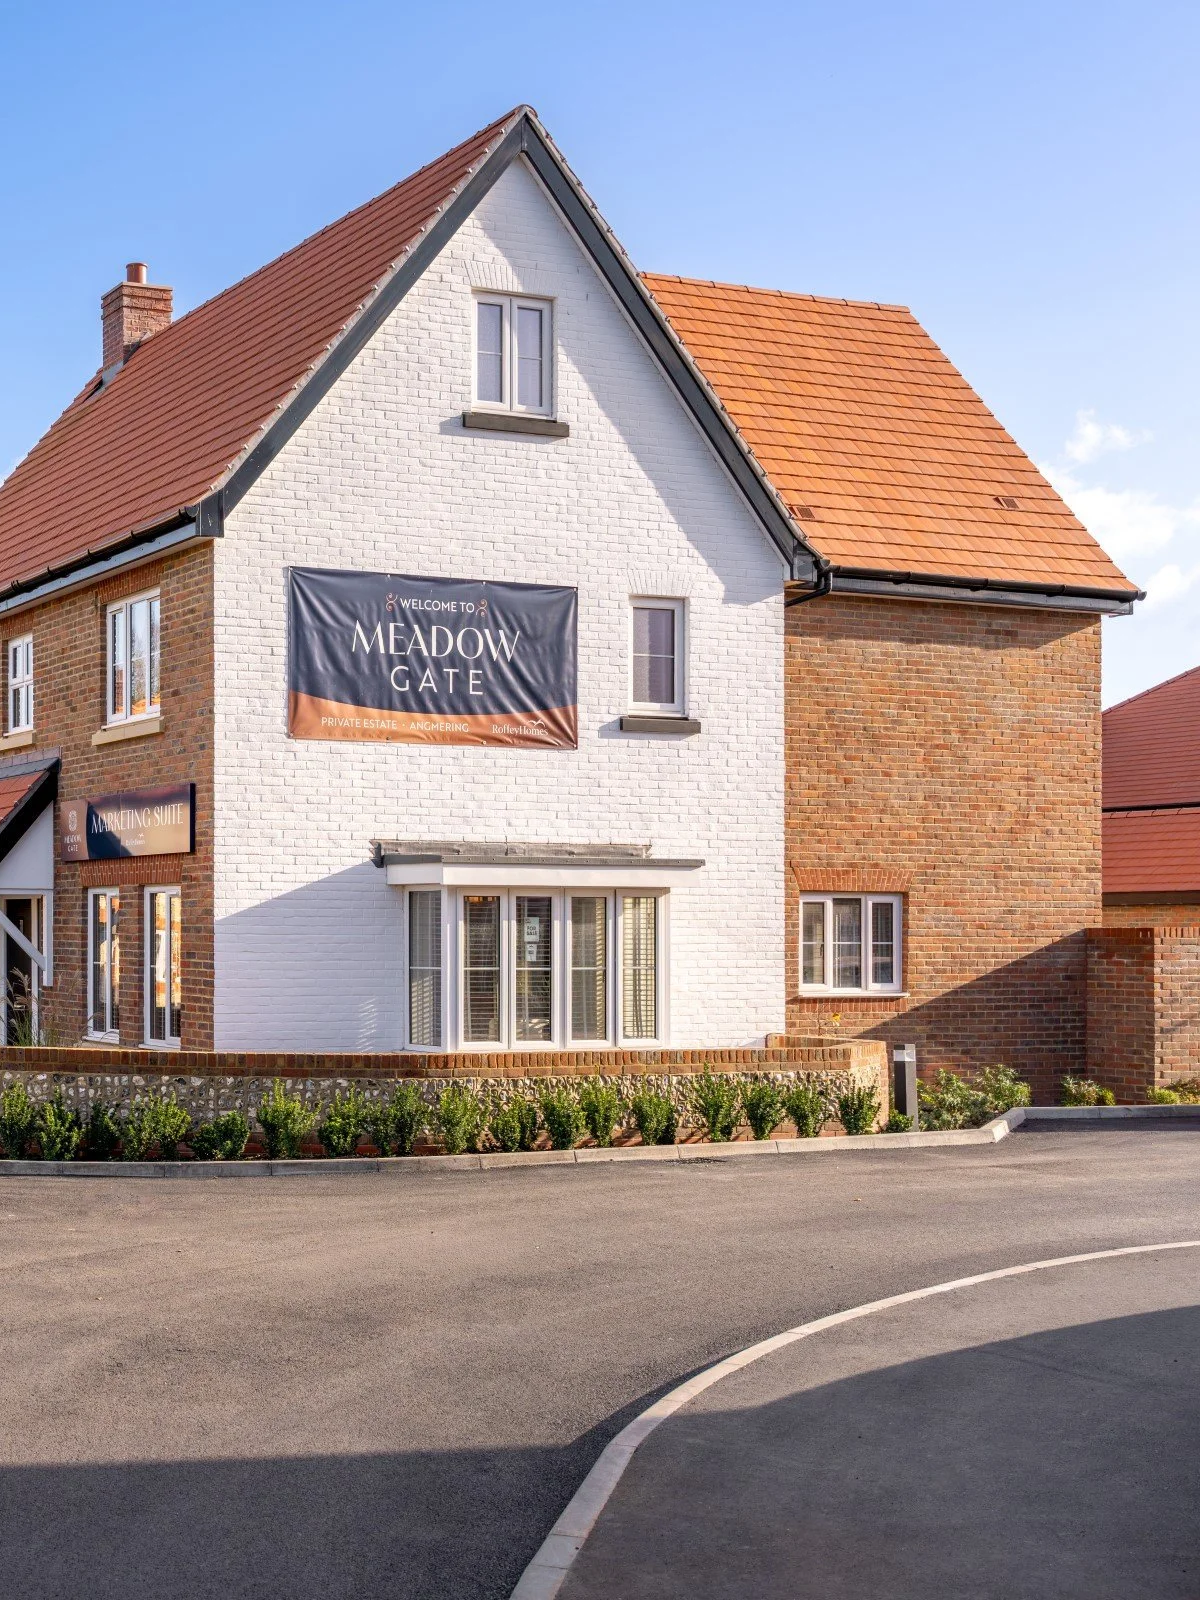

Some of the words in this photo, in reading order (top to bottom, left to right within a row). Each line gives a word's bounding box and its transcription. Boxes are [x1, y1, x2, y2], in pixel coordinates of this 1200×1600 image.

[400, 598, 458, 612] WELCOME
[460, 602, 475, 613] TO
[352, 619, 520, 662] MEADOW
[390, 665, 484, 695] GATE
[321, 717, 361, 728] PRIVATE
[363, 719, 397, 729] ESTATE
[410, 722, 469, 732] ANGMERING
[91, 807, 151, 834] MARKETING
[153, 803, 183, 827] SUITE
